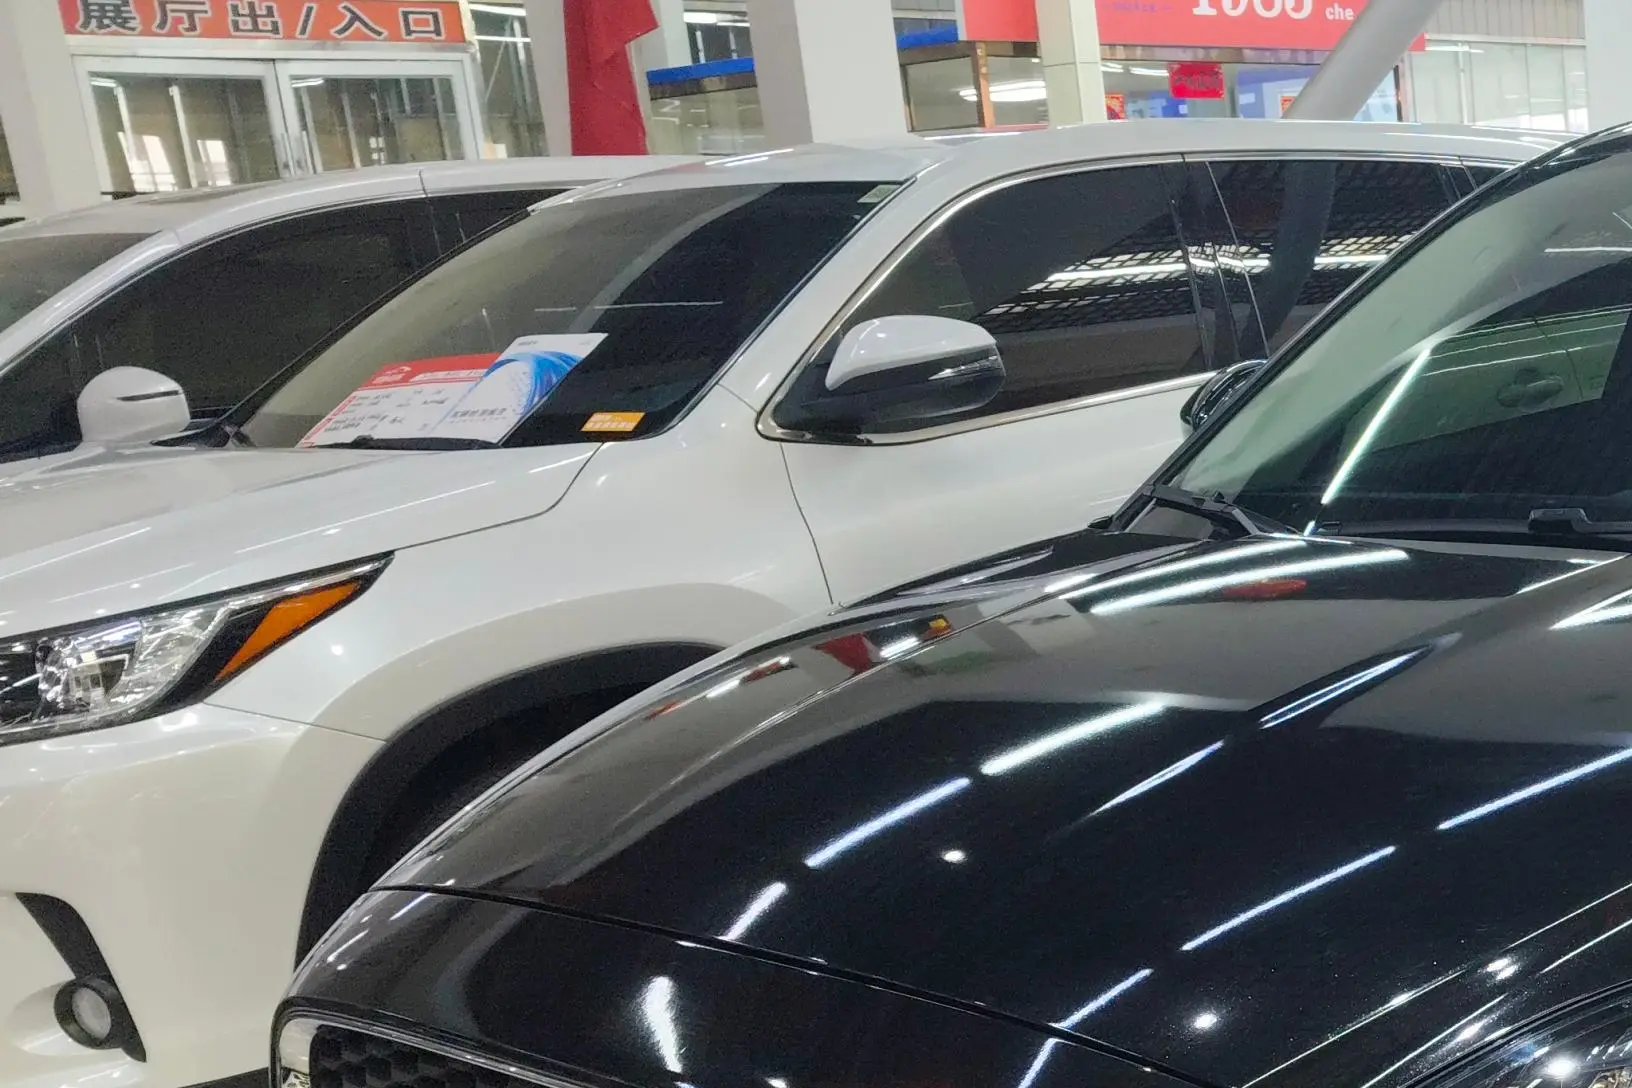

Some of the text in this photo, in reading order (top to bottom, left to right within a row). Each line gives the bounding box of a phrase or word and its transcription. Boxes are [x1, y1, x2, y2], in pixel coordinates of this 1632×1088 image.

[79, 0, 445, 38] 展厅出/入口
[1325, 3, 1355, 21] che
